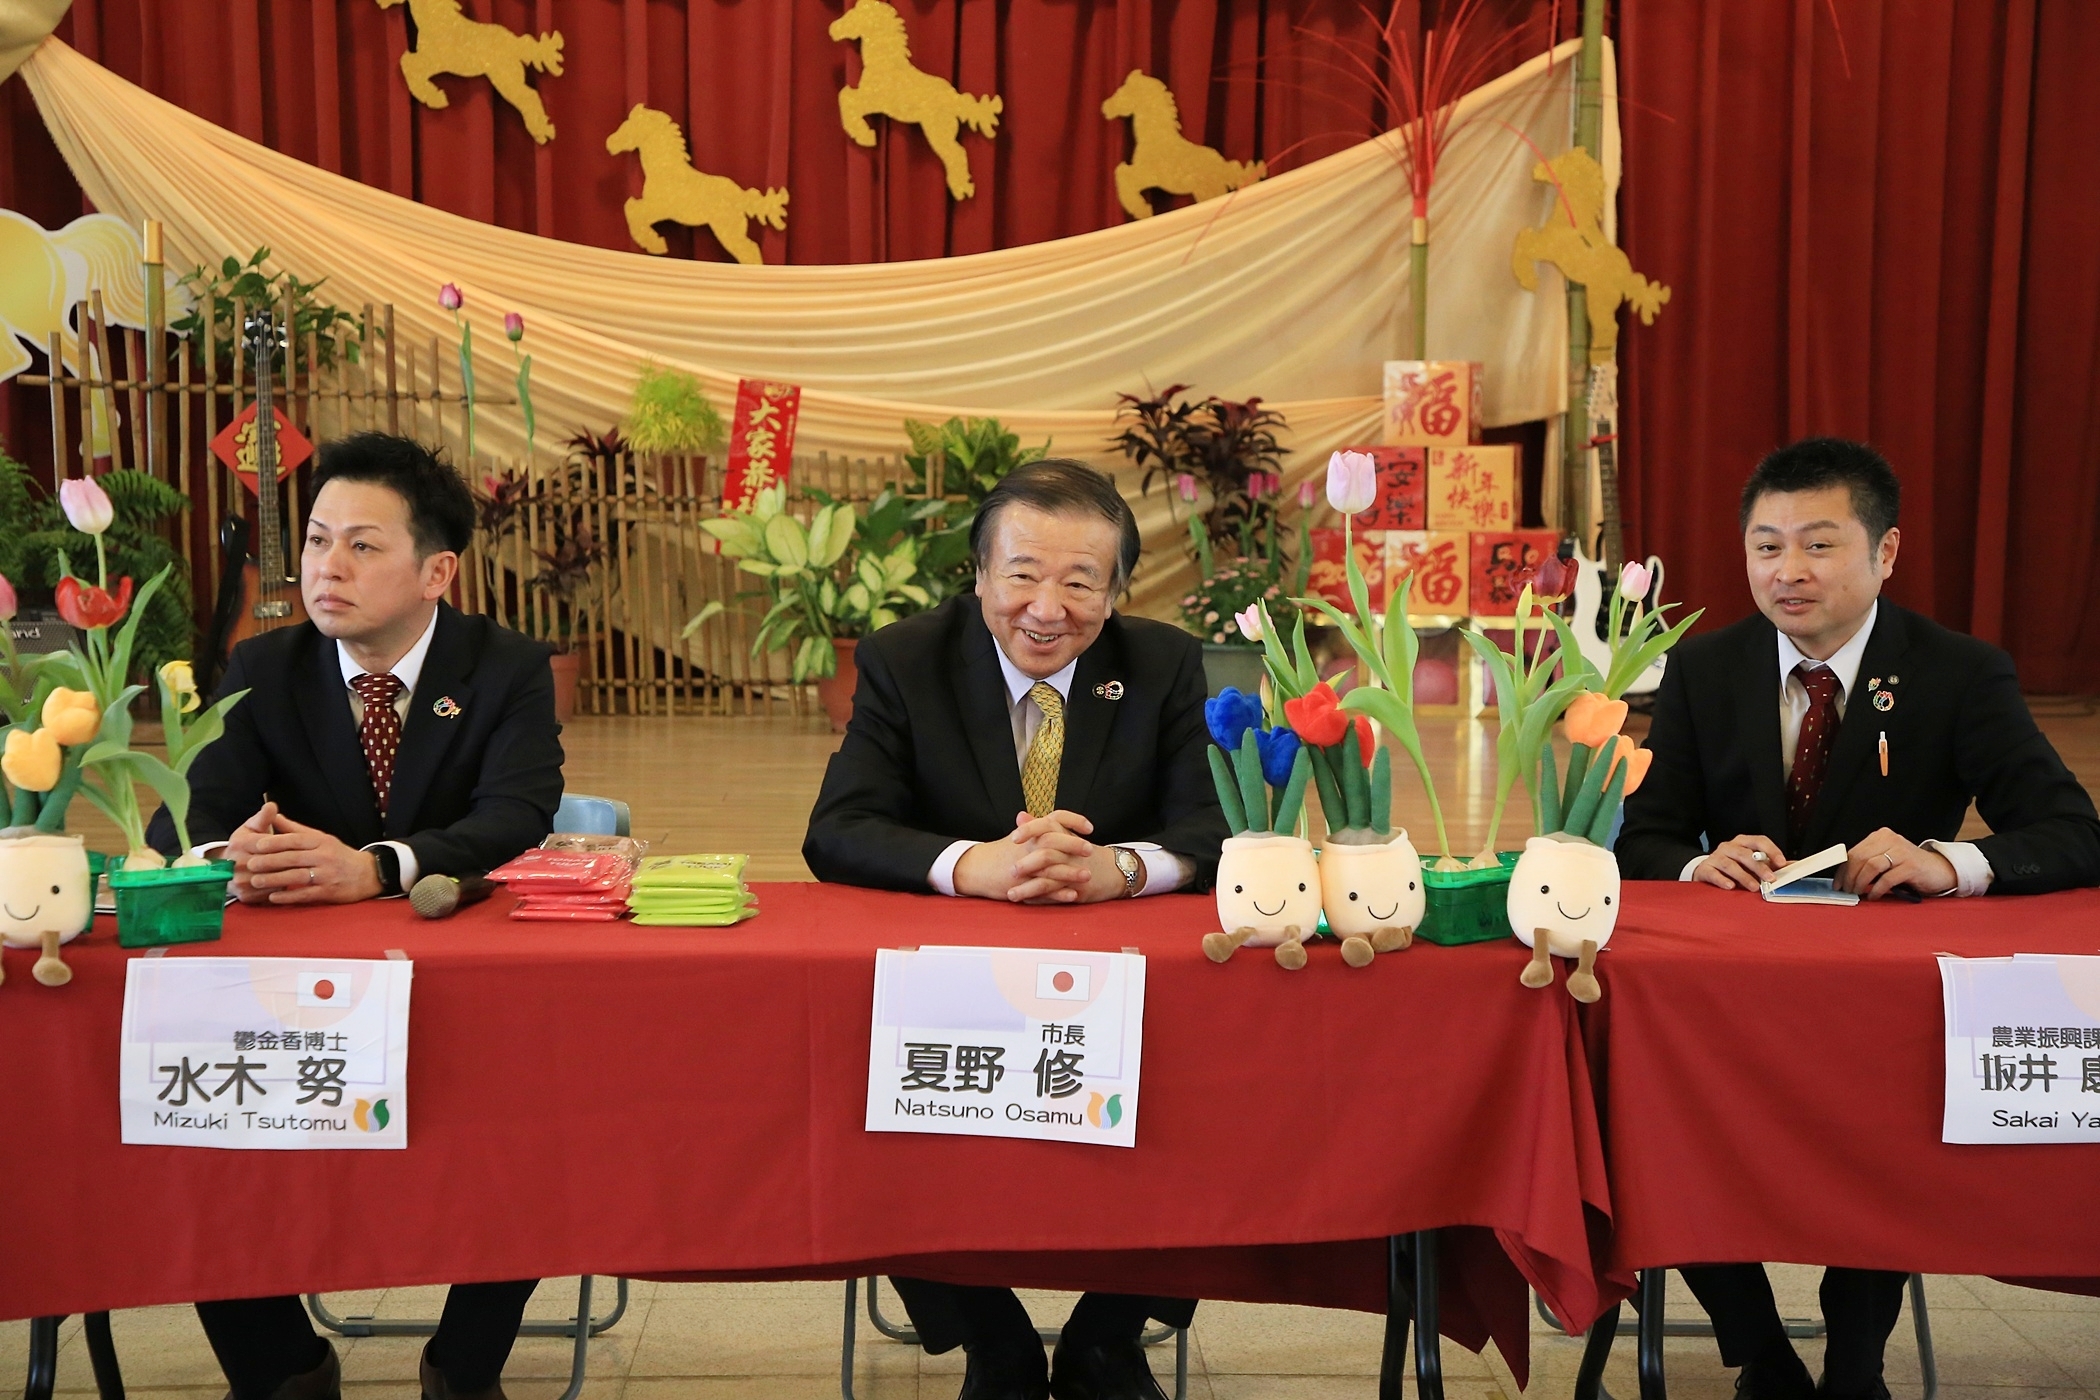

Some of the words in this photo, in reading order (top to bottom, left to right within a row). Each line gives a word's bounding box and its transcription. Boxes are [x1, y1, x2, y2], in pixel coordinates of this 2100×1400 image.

[233, 1030, 348, 1052] 鬱金香博士
[1042, 1023, 1086, 1046] 市長
[1992, 1026, 2100, 1050] 農業振興課
[158, 1056, 267, 1107] 水木
[296, 1055, 347, 1107] 努
[900, 1042, 1006, 1094] 夏野
[1032, 1048, 1085, 1099] 修
[1979, 1053, 2059, 1093] 坂井
[154, 1111, 228, 1130] Mizuki
[241, 1112, 347, 1131] Tsutomu
[895, 1098, 994, 1119] Natsuno
[1005, 1103, 1083, 1126] Osamu
[1992, 1110, 2059, 1128] Sakai
